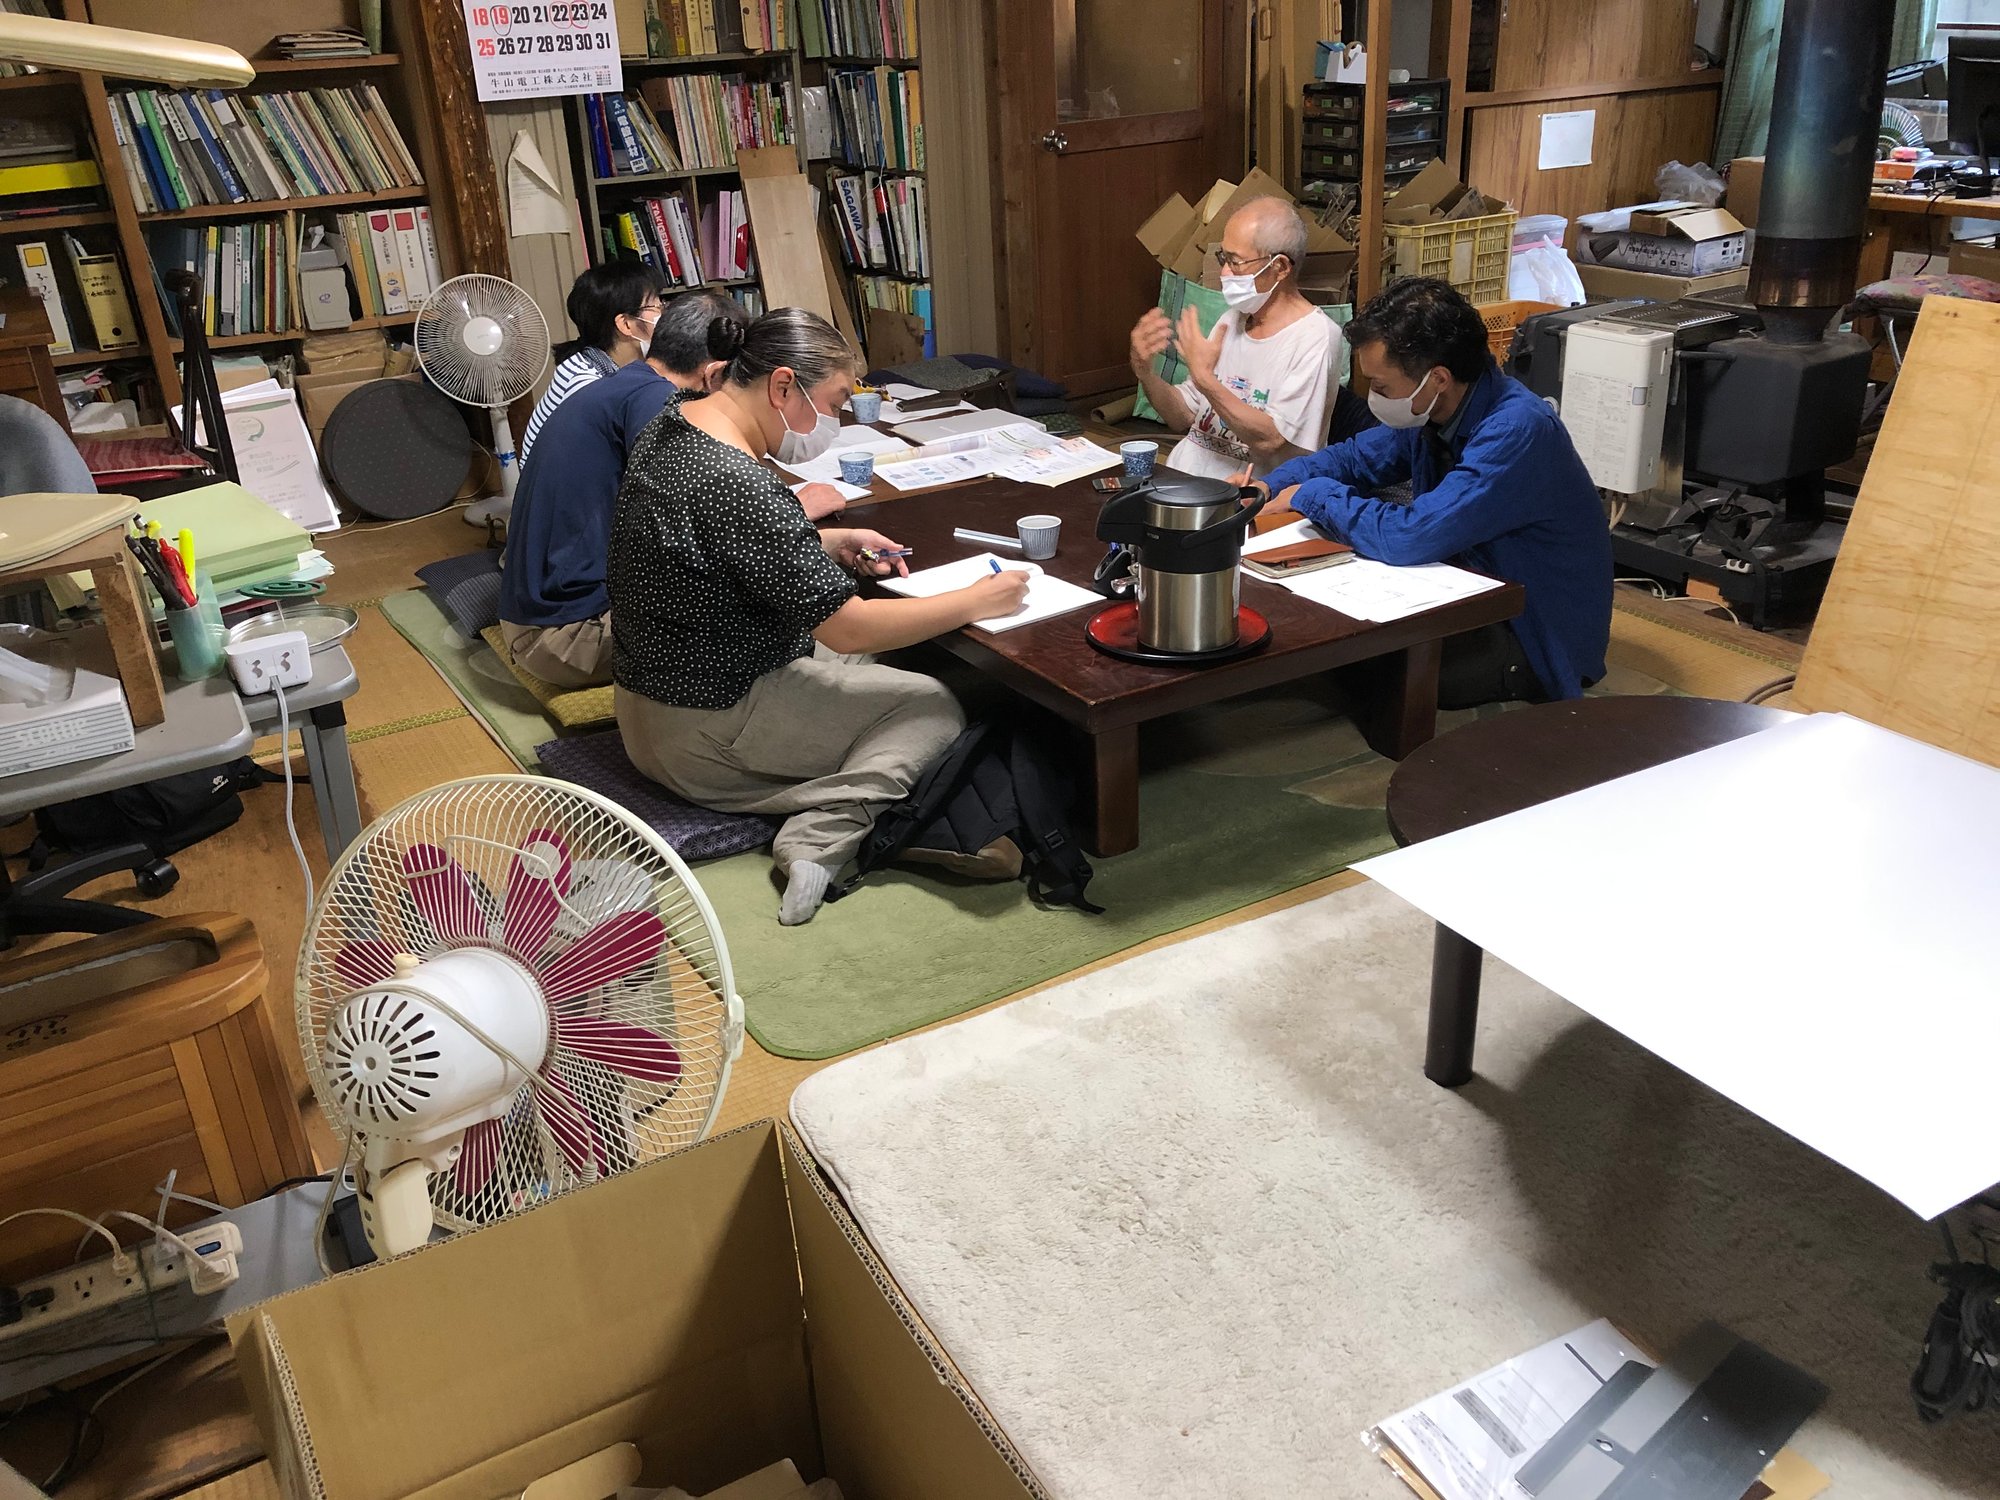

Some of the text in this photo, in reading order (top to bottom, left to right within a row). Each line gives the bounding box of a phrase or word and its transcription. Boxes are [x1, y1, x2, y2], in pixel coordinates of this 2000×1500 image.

[473, 3, 607, 26] 18 19 20 21 22 23 24
[477, 32, 611, 57] 25 26 27 28 29 30 31
[491, 72, 593, 88] 牛山電工株式会社
[840, 180, 863, 231] SAGAWA
[650, 202, 670, 247] TAKIGEN
